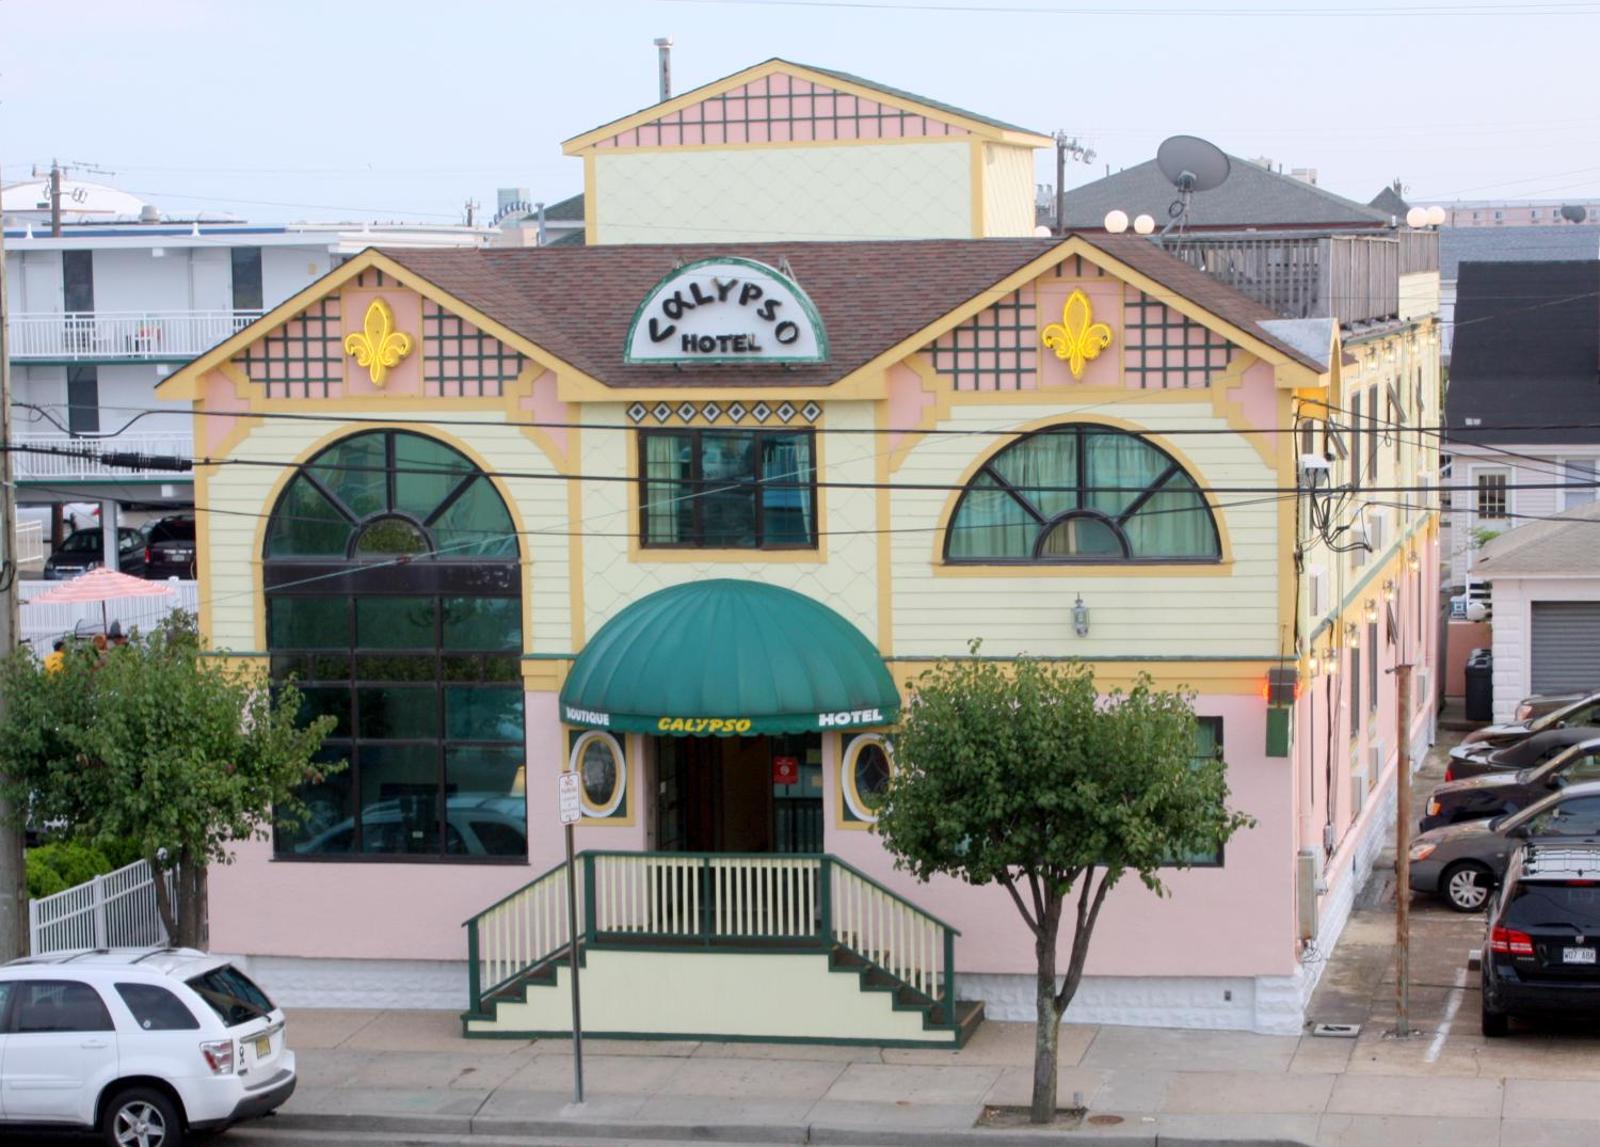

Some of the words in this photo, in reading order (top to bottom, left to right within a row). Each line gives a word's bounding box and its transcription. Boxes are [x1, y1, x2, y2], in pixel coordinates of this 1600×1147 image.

[681, 334, 762, 353] HOTEL
[658, 717, 752, 733] CALYPSO
[818, 708, 884, 727] HOTEL
